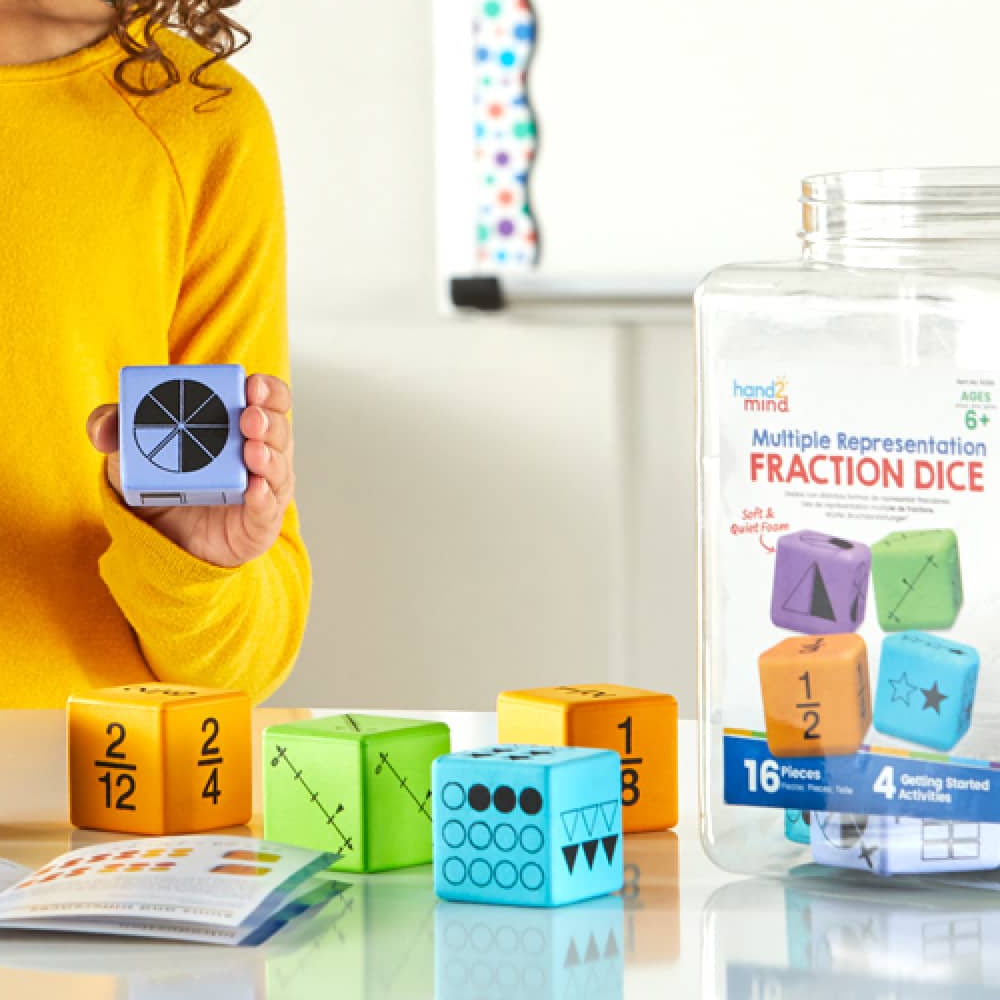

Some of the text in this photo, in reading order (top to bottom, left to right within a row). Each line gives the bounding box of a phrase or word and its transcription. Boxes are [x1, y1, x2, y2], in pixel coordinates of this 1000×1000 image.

[744, 396, 789, 412] mind
[961, 391, 991, 402] AGES
[964, 410, 990, 430] 6+
[752, 428, 987, 457] Multiple Representation
[750, 452, 985, 492] FRACTION DICE
[742, 507, 762, 520] Soft
[799, 671, 812, 699] 1
[106, 722, 126, 759] 2
[202, 717, 220, 756] 2
[617, 716, 633, 754] 1
[803, 710, 821, 740] 2
[98, 771, 136, 811] 12
[202, 767, 221, 805] 4
[621, 768, 640, 806] 8
[743, 758, 780, 793] 16
[781, 765, 821, 780] Pieces
[873, 765, 896, 800] 4
[901, 774, 943, 792] Getting
[945, 776, 990, 791] Started
[899, 789, 952, 802] Activities
